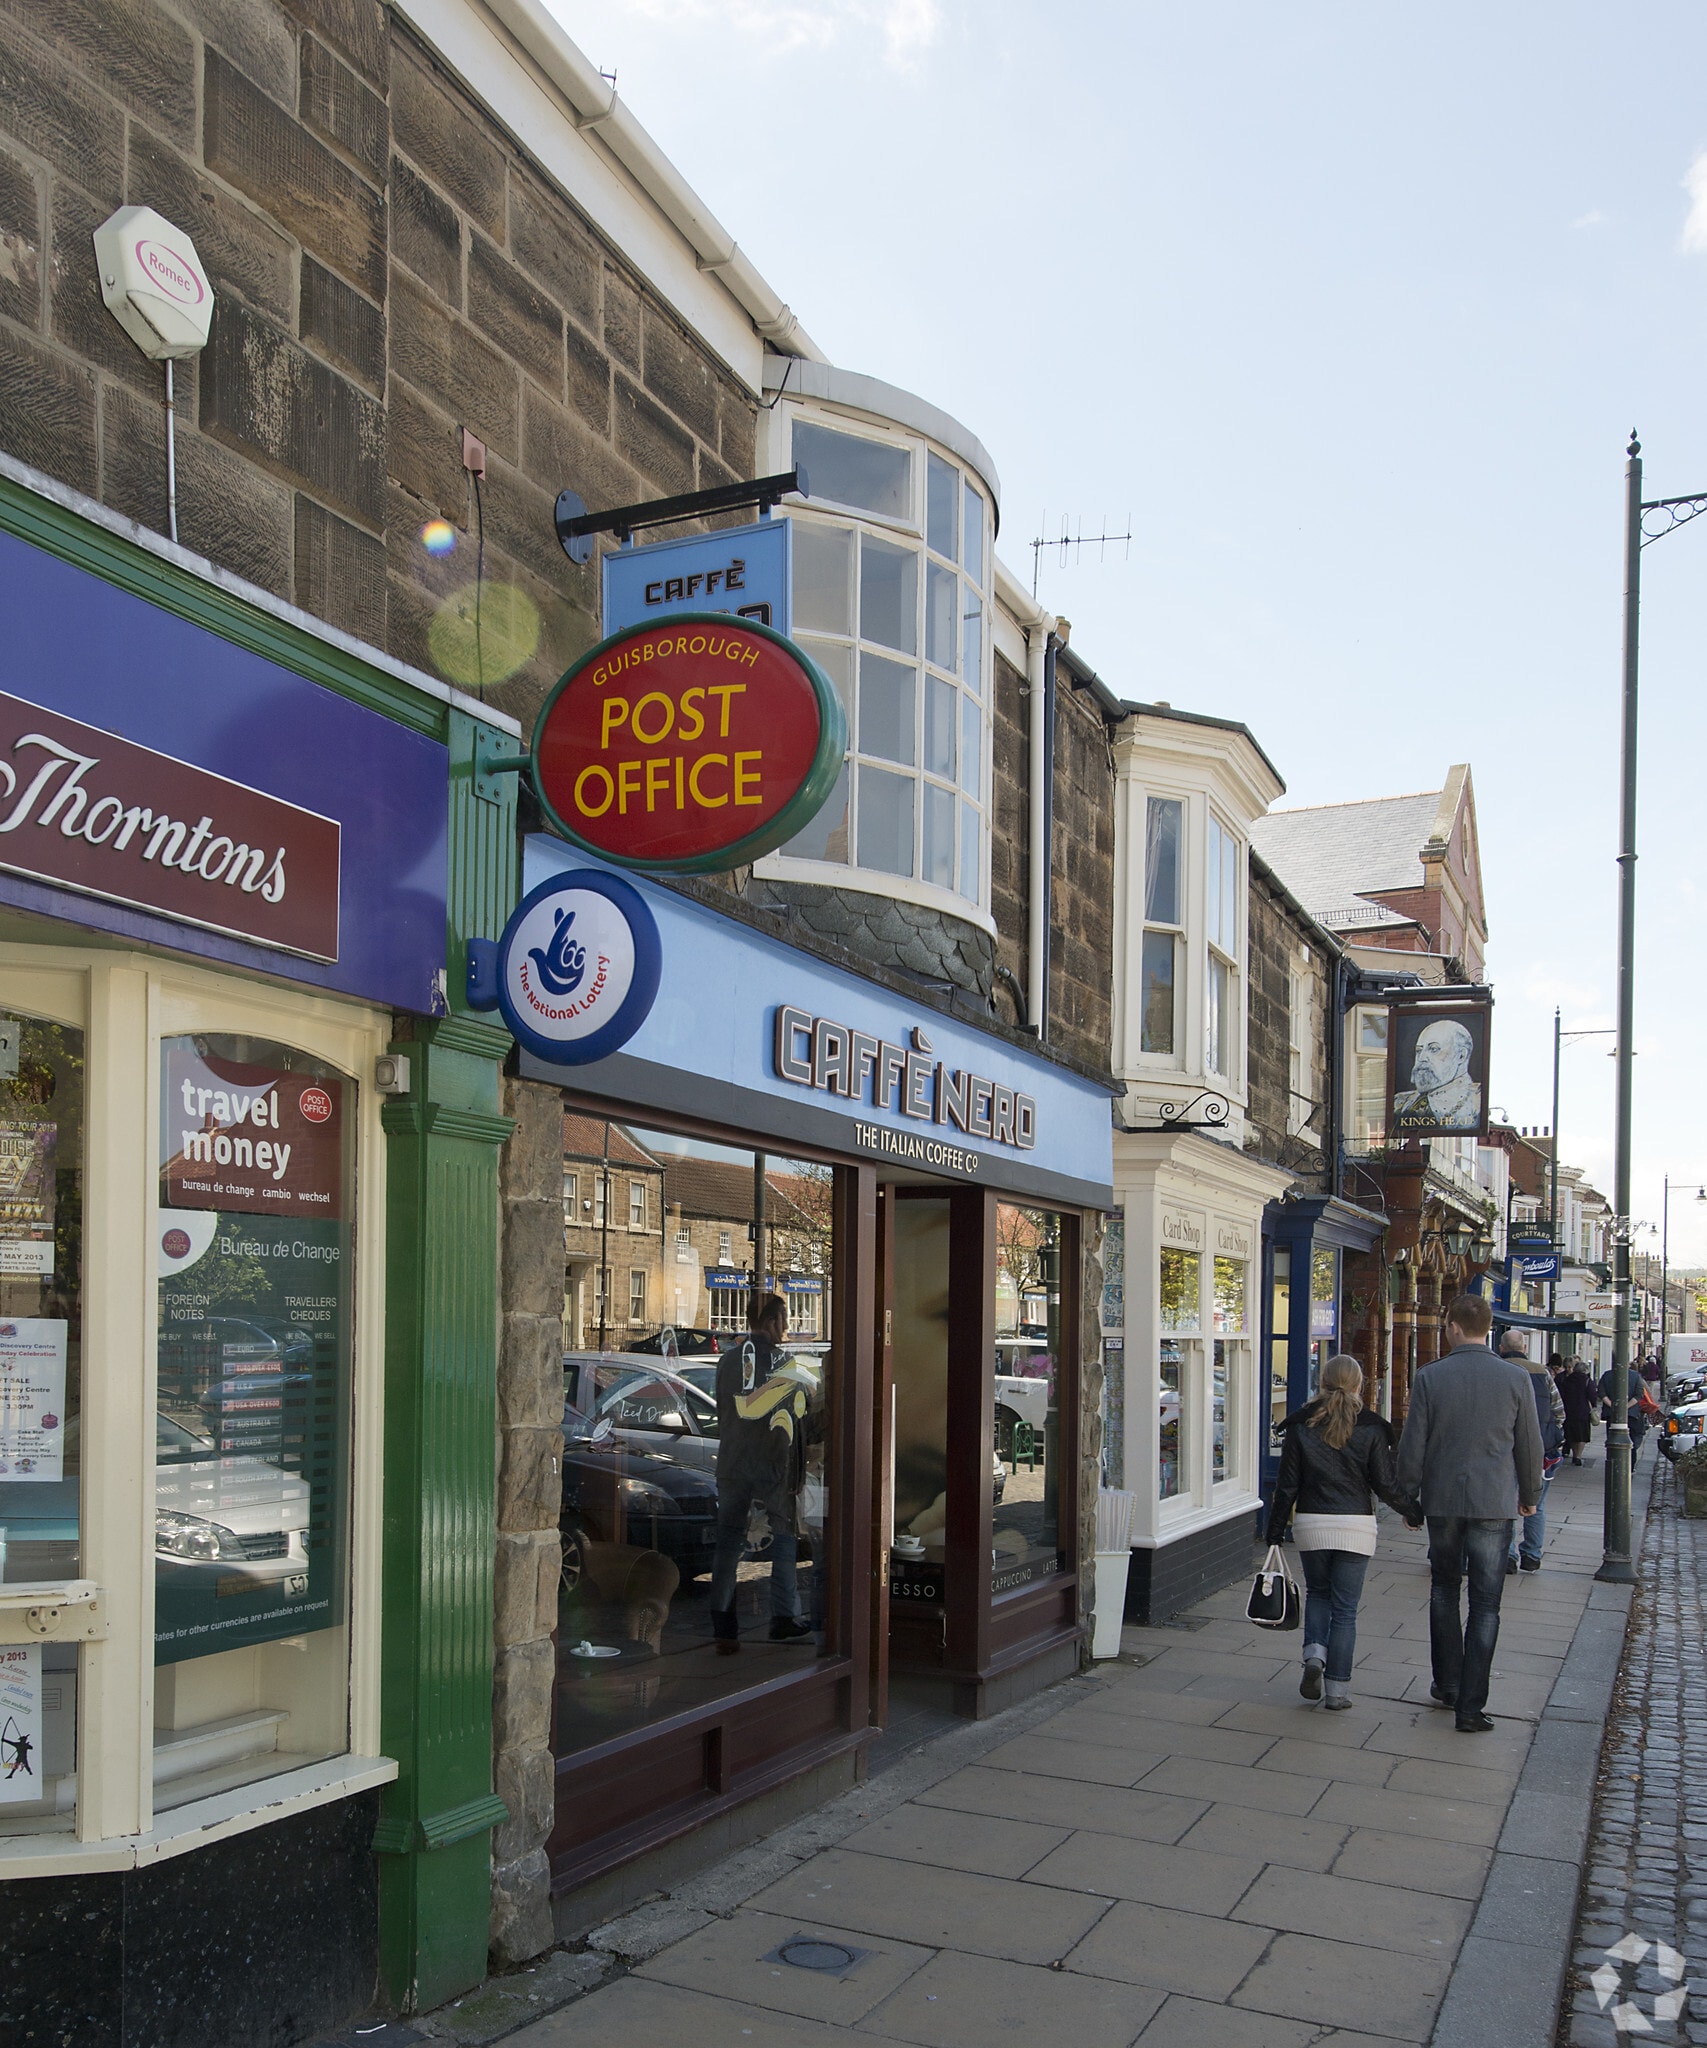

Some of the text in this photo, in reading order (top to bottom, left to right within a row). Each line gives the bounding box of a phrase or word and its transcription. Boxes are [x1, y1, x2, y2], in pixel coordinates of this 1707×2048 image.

[149, 252, 191, 292] Romec
[593, 636, 760, 687] GUISBOROUGH
[601, 684, 747, 749] POST
[574, 750, 763, 818] OFFICE
[0, 733, 286, 903] Thorntons
[519, 955, 611, 1020] The National Lottery
[181, 1078, 280, 1130] travel
[306, 1094, 326, 1105] POST
[935, 1061, 1036, 1150] NERO
[302, 1103, 328, 1115] OFFICE
[18, 1121, 37, 1132] TOUR
[1400, 1116, 1474, 1127] KINGS HEAD
[854, 1122, 878, 1149] THE
[880, 1130, 925, 1160] ITALIAN
[926, 1142, 963, 1171] COFFEE
[181, 1130, 291, 1180] money
[182, 1178, 331, 1203] bureau de change cambio wechsel
[1163, 1215, 1201, 1248] Card Shop
[1512, 1230, 1551, 1240] COURTYARD
[1217, 1228, 1249, 1259] Card Shop
[220, 1236, 340, 1264] Bureau de Change
[24, 1253, 44, 1261] 2013
[165, 1294, 210, 1306] FOREIGN
[285, 1296, 337, 1307] TRAVELLERS
[171, 1309, 204, 1320] NOTES
[290, 1310, 331, 1321] CHEQUES
[169, 1333, 181, 1341] BUY
[192, 1333, 217, 1341] WE SELL
[324, 1332, 336, 1340] SELL
[237, 1419, 271, 1428] AUSTRALIA
[236, 1438, 262, 1447] CANADA
[236, 1455, 279, 1465] SWITZERLAND
[991, 1558, 1058, 1593] CAPPUCCINO LATTE
[176, 1627, 187, 1637] for
[189, 1624, 209, 1636] other
[211, 1615, 249, 1631] currencies
[250, 1614, 262, 1623] are
[263, 1606, 293, 1620] available
[294, 1605, 303, 1613] on
[304, 1599, 329, 1612] request
[7, 1651, 27, 1661] 2013
